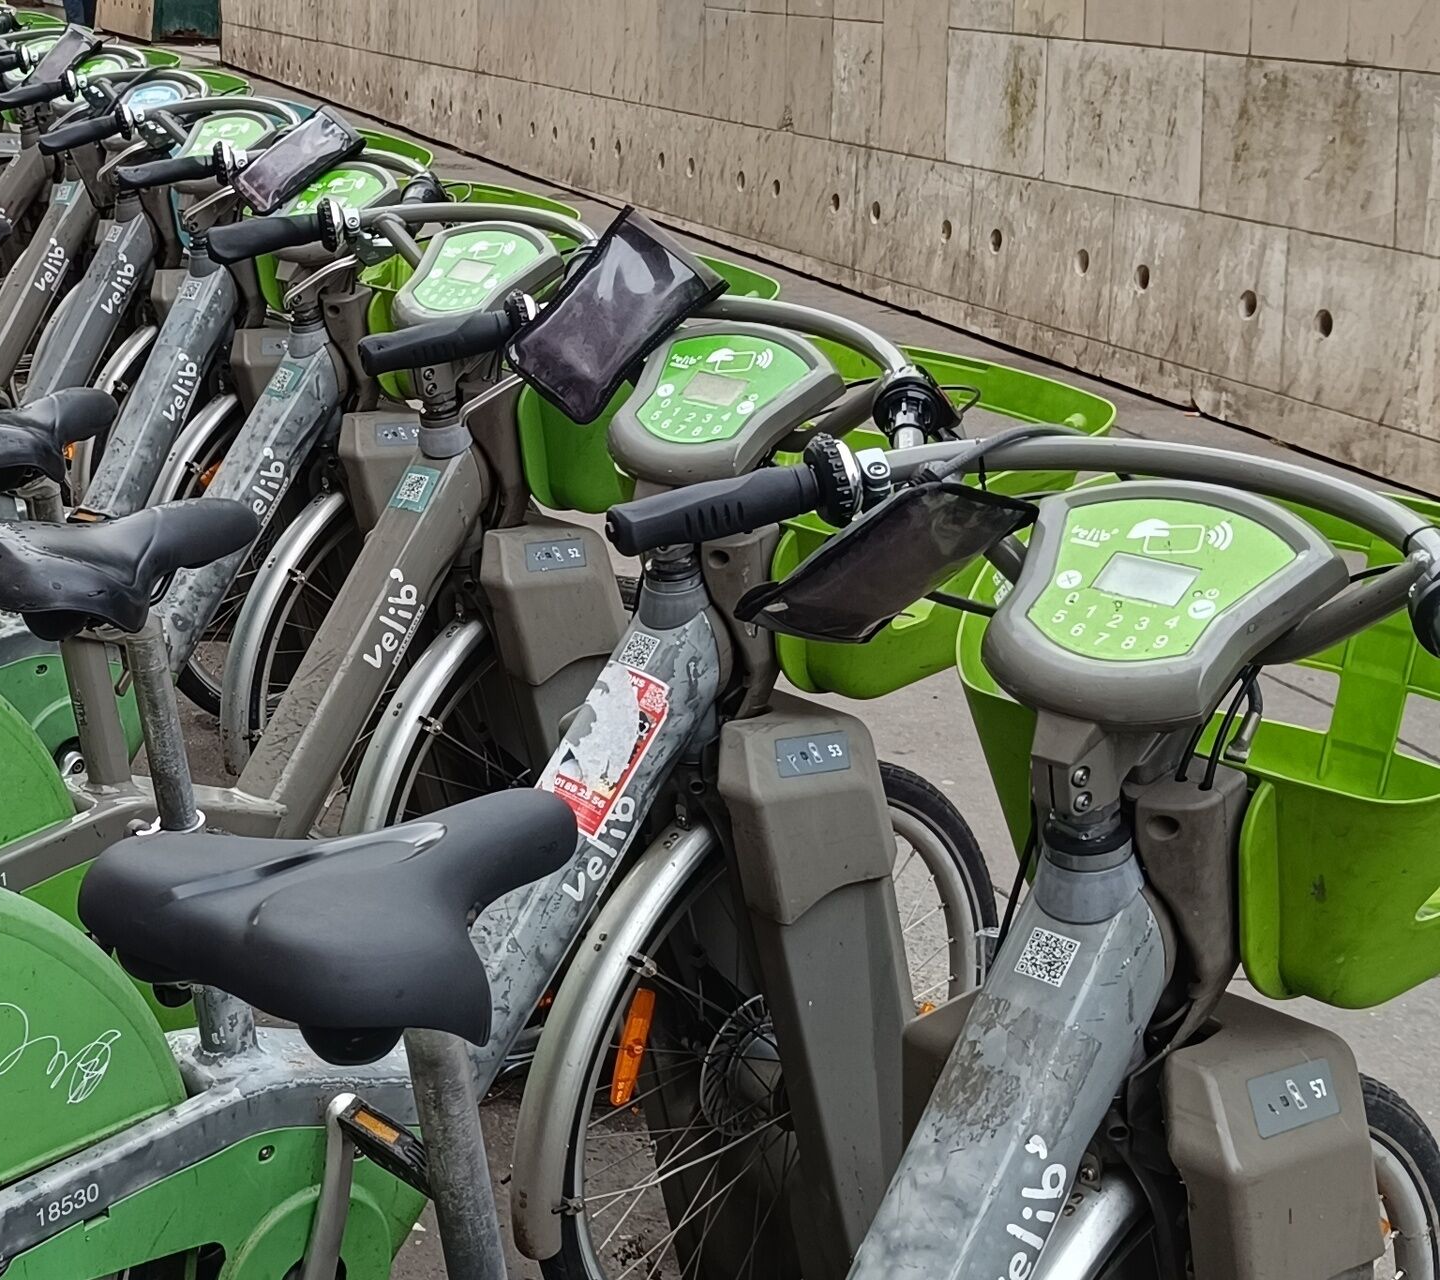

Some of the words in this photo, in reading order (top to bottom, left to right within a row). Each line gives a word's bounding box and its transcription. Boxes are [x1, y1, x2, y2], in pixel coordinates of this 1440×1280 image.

[651, 411, 662, 420] 5
[661, 419, 672, 428] 6
[675, 425, 687, 434] 7
[692, 426, 702, 436] 8
[711, 425, 722, 435] 9
[661, 399, 671, 408] 0
[672, 407, 681, 416] 1
[684, 413, 696, 422] 2
[702, 414, 713, 423] 3
[252, 447, 285, 516] elib'
[568, 548, 581, 559] 52
[1065, 592, 1079, 605] 0
[1087, 605, 1097, 618] 1
[1107, 614, 1123, 628] 2
[1135, 617, 1150, 630] 3
[1164, 616, 1180, 629] 4
[1052, 610, 1067, 623] 5
[1070, 623, 1086, 636] 6
[1094, 632, 1109, 645] 7
[1121, 636, 1136, 649] 8
[1153, 634, 1169, 648] 9
[827, 744, 843, 757] 53
[562, 796, 636, 902] velib
[1309, 1078, 1327, 1099] 57
[36, 1183, 99, 1226] 18530
